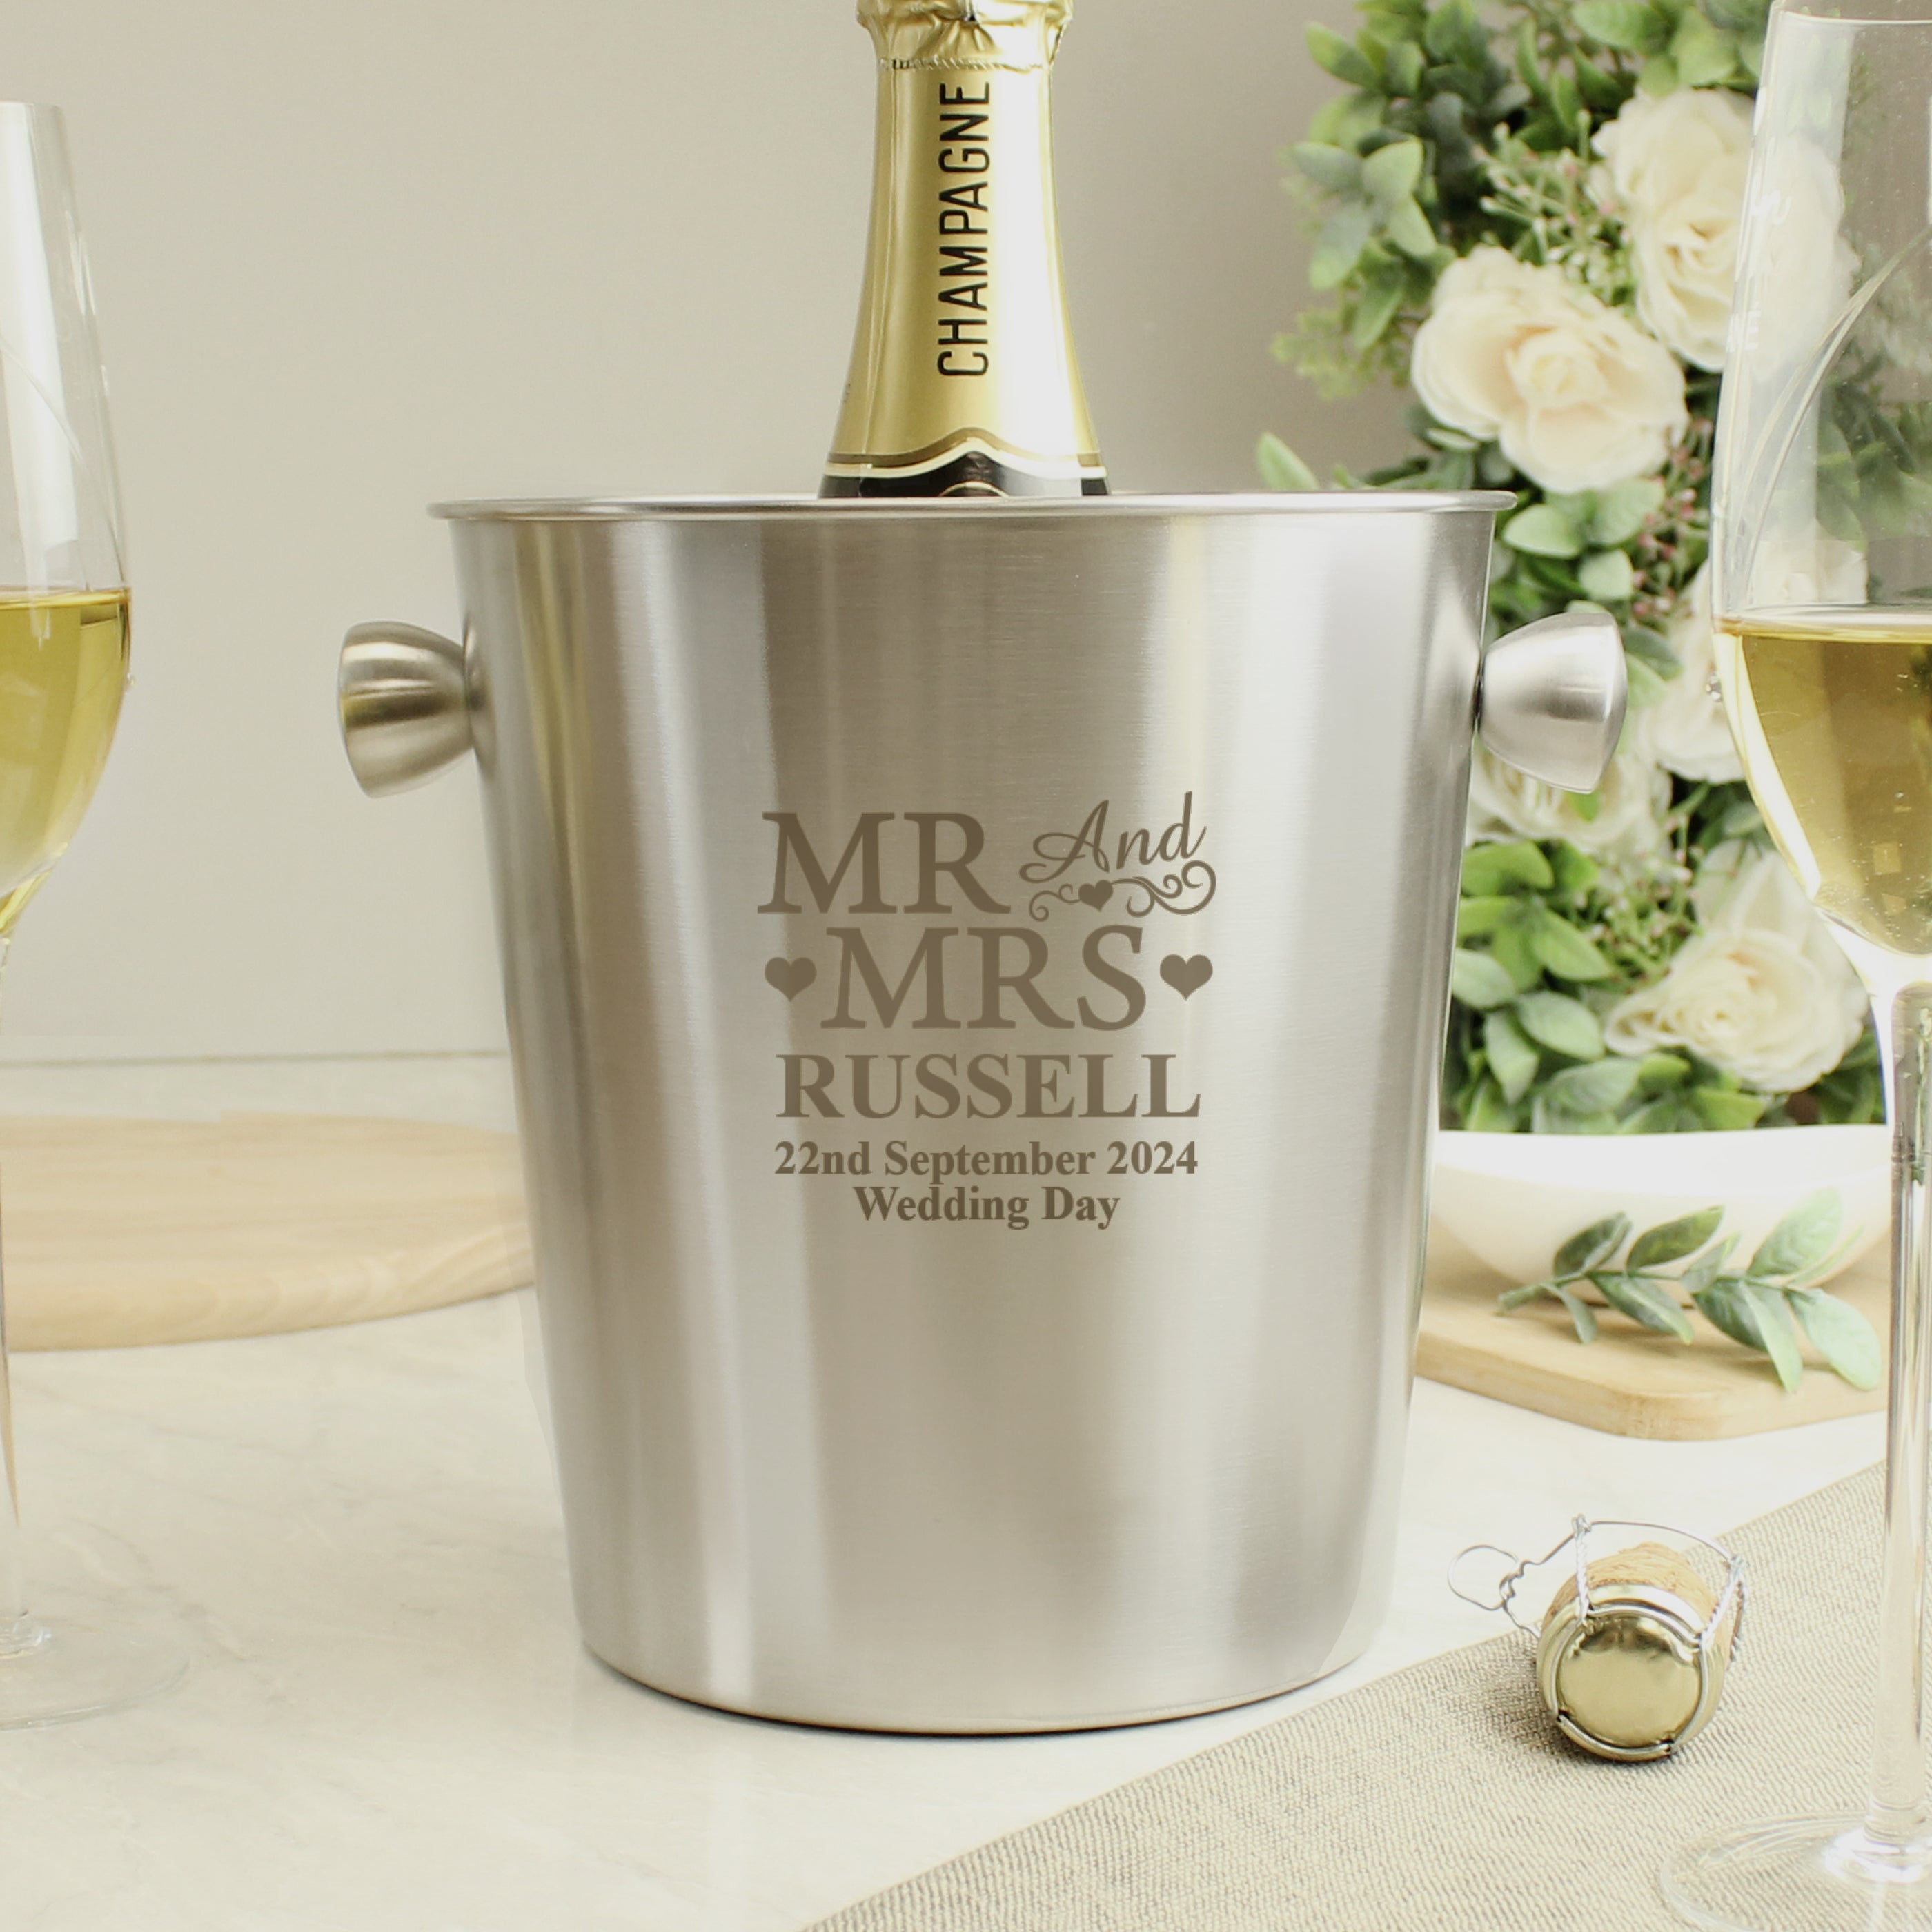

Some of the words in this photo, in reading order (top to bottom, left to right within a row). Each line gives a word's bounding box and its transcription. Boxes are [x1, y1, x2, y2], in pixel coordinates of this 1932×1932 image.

[937, 81, 991, 377] CHAMPAGNE
[757, 811, 1012, 914] MR
[1018, 791, 1208, 884] And
[820, 924, 1147, 1032] MRS
[775, 1053, 1201, 1119] RUSSELL
[774, 1141, 871, 1175] 22nd
[885, 1140, 1096, 1185] September
[1107, 1141, 1199, 1174] 2024
[853, 1185, 1029, 1230] Wedding
[1041, 1185, 1121, 1230] Day
